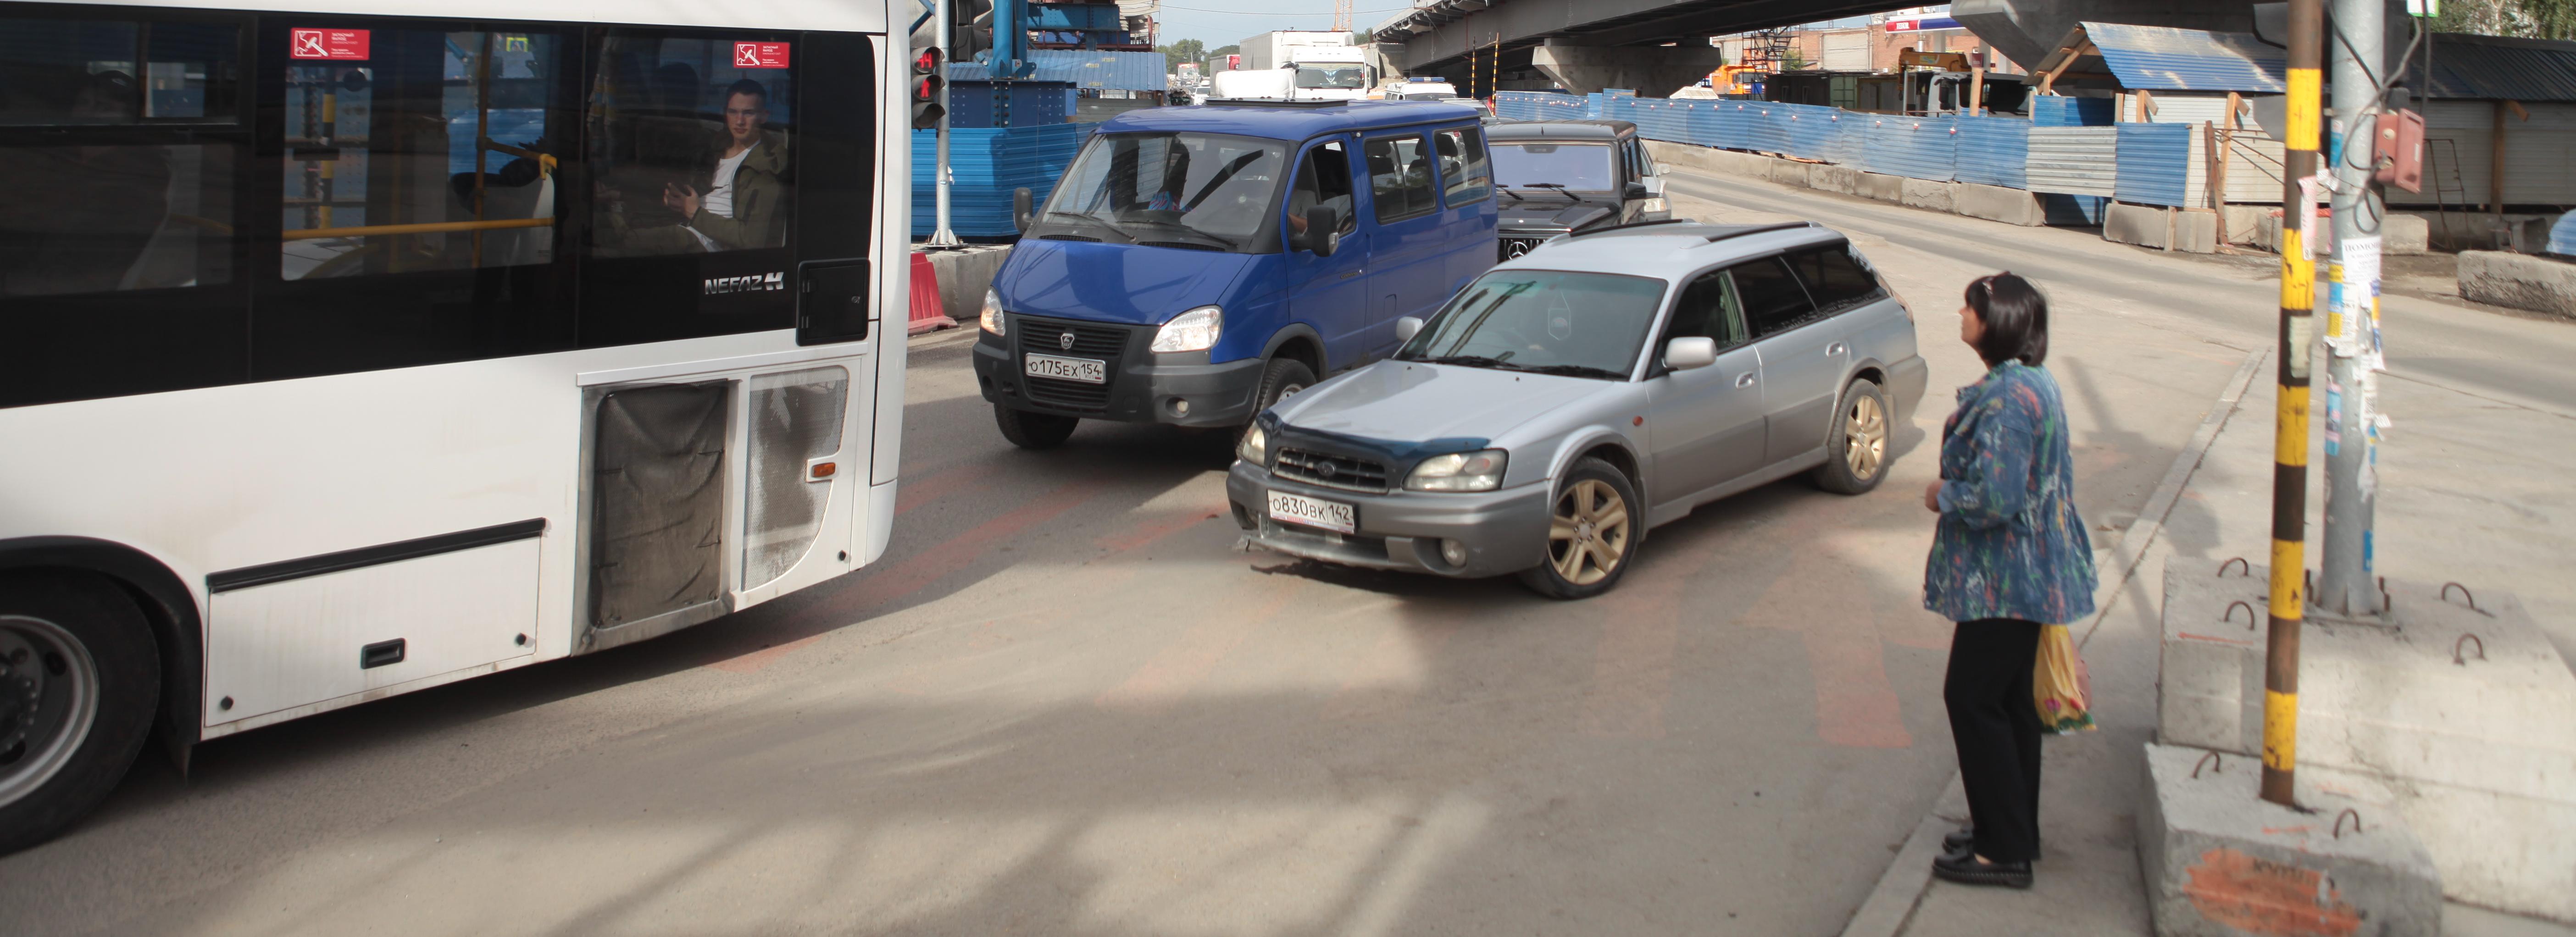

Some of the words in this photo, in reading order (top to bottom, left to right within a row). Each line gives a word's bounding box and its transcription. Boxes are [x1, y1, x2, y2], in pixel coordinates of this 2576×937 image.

[705, 275, 762, 294] NEFAZ
[1081, 363, 1099, 376] 154
[1328, 504, 1350, 521] 142
